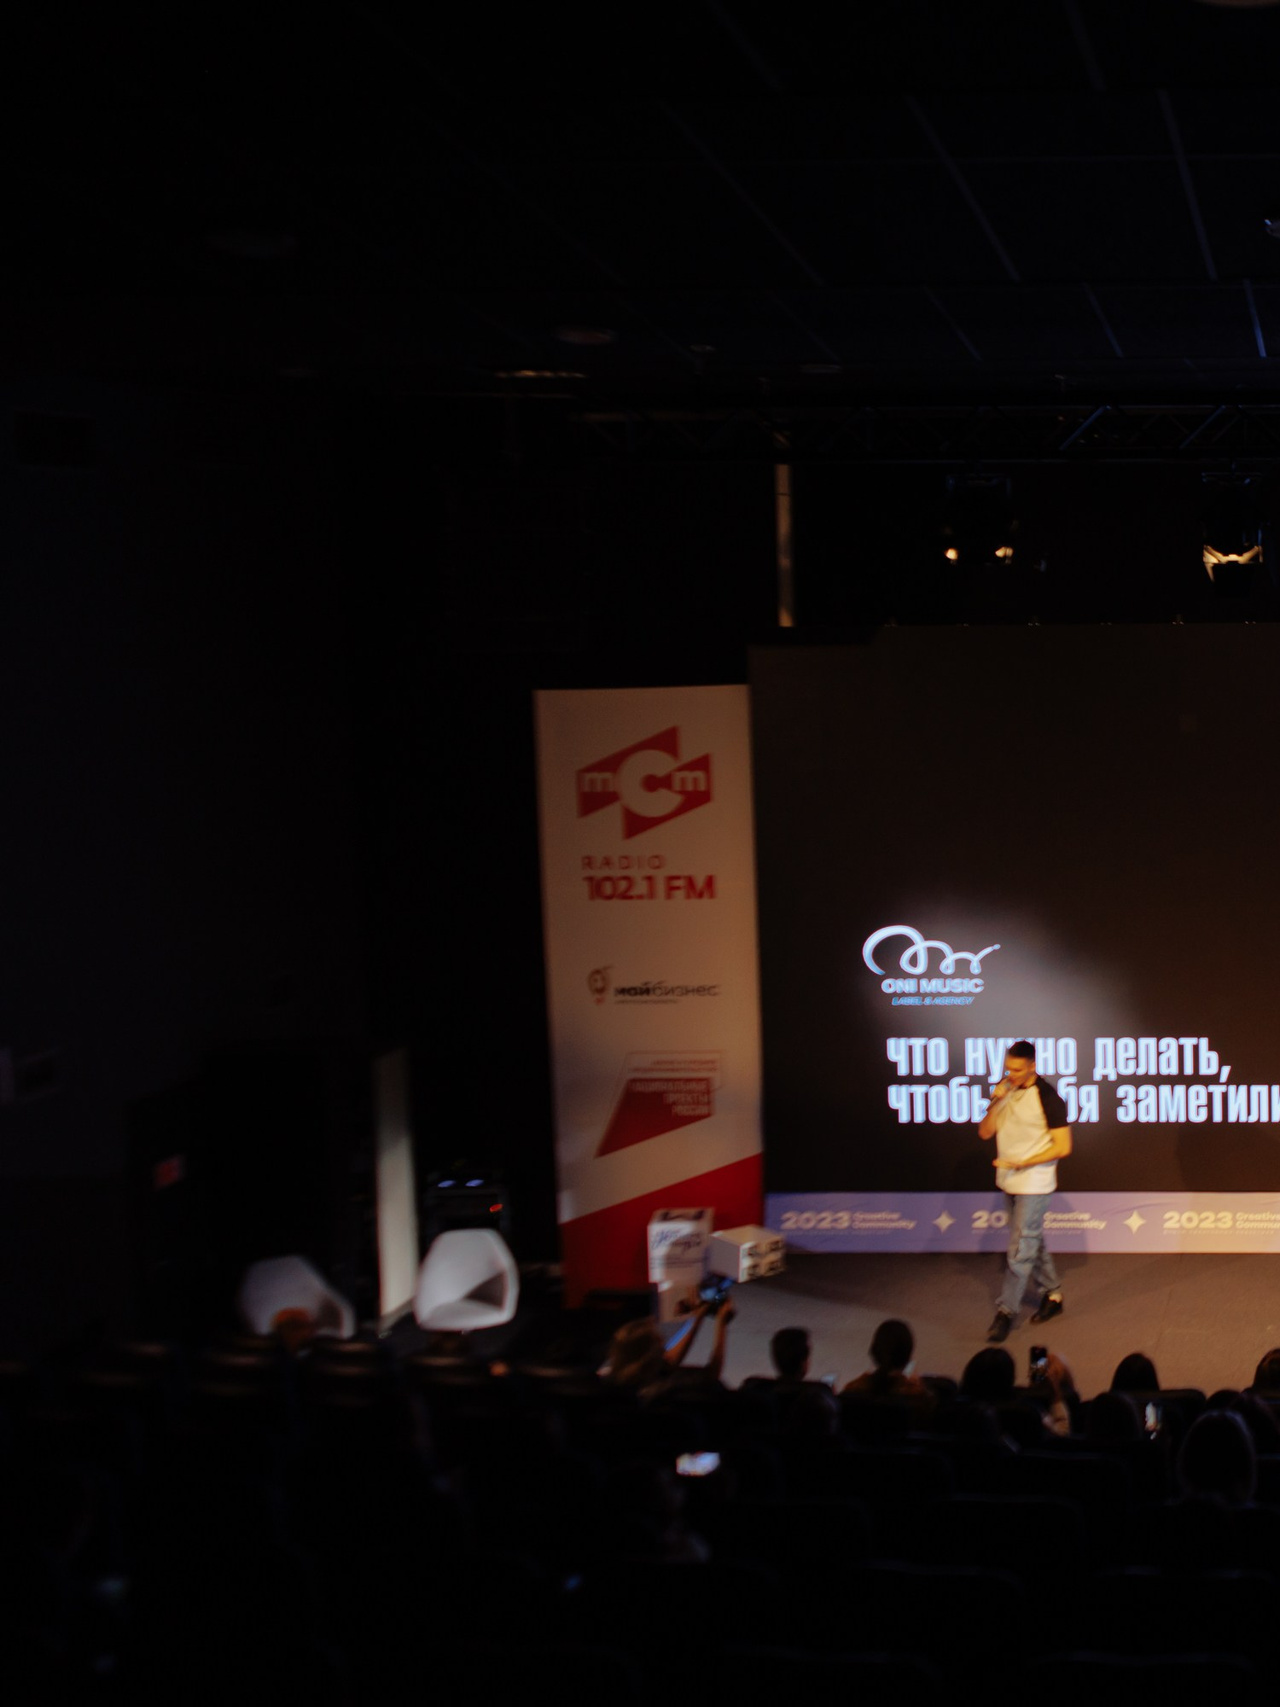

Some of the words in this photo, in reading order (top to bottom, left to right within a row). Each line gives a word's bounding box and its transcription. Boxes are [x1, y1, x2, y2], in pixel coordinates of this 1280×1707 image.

[581, 855, 666, 870] RADIO
[582, 874, 656, 900] 102.1
[664, 874, 717, 900] FM
[919, 978, 984, 993] MUSIC
[891, 996, 922, 1006] LABEL
[932, 996, 975, 1006] AGENCY
[886, 1037, 949, 1076] что
[965, 1037, 1077, 1083] нуно
[1093, 1037, 1232, 1083] делать,
[780, 1210, 850, 1230] 2023
[971, 1210, 1009, 1228] 20
[1042, 1210, 1091, 1220] Creative
[1163, 1210, 1234, 1230] 2023
[1042, 1220, 1107, 1231] Community
